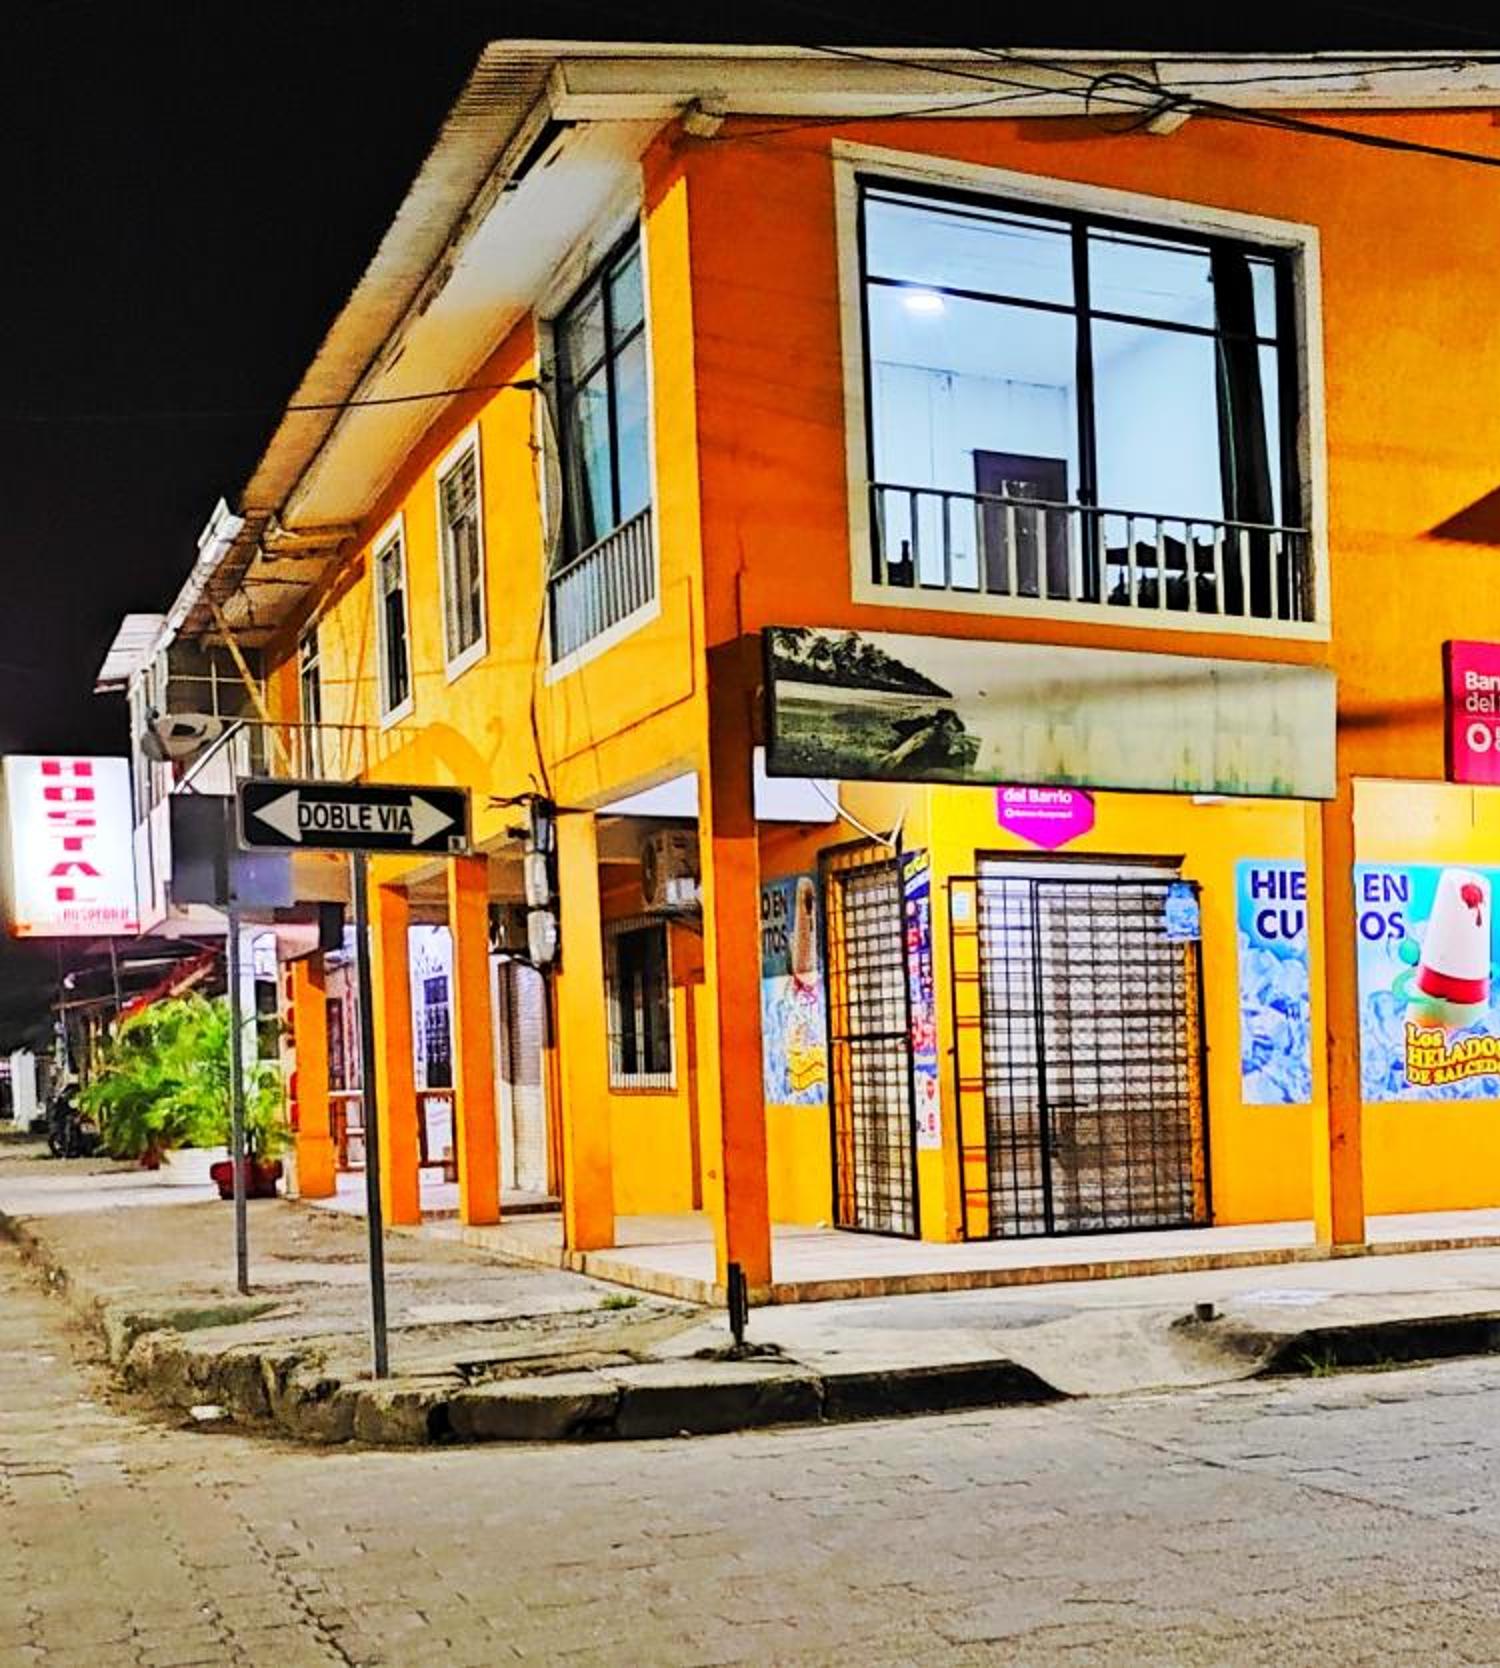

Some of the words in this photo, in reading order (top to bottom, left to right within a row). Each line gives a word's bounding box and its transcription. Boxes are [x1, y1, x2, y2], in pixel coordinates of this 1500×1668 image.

[1466, 693, 1495, 713] del
[1003, 788, 1027, 803] del
[1028, 788, 1073, 804] Barrio
[298, 803, 371, 830] DOBLE
[377, 805, 414, 831] VIA
[41, 761, 101, 902] HOSTAL
[1363, 874, 1408, 902] EN
[1407, 1065, 1431, 1086] DE
